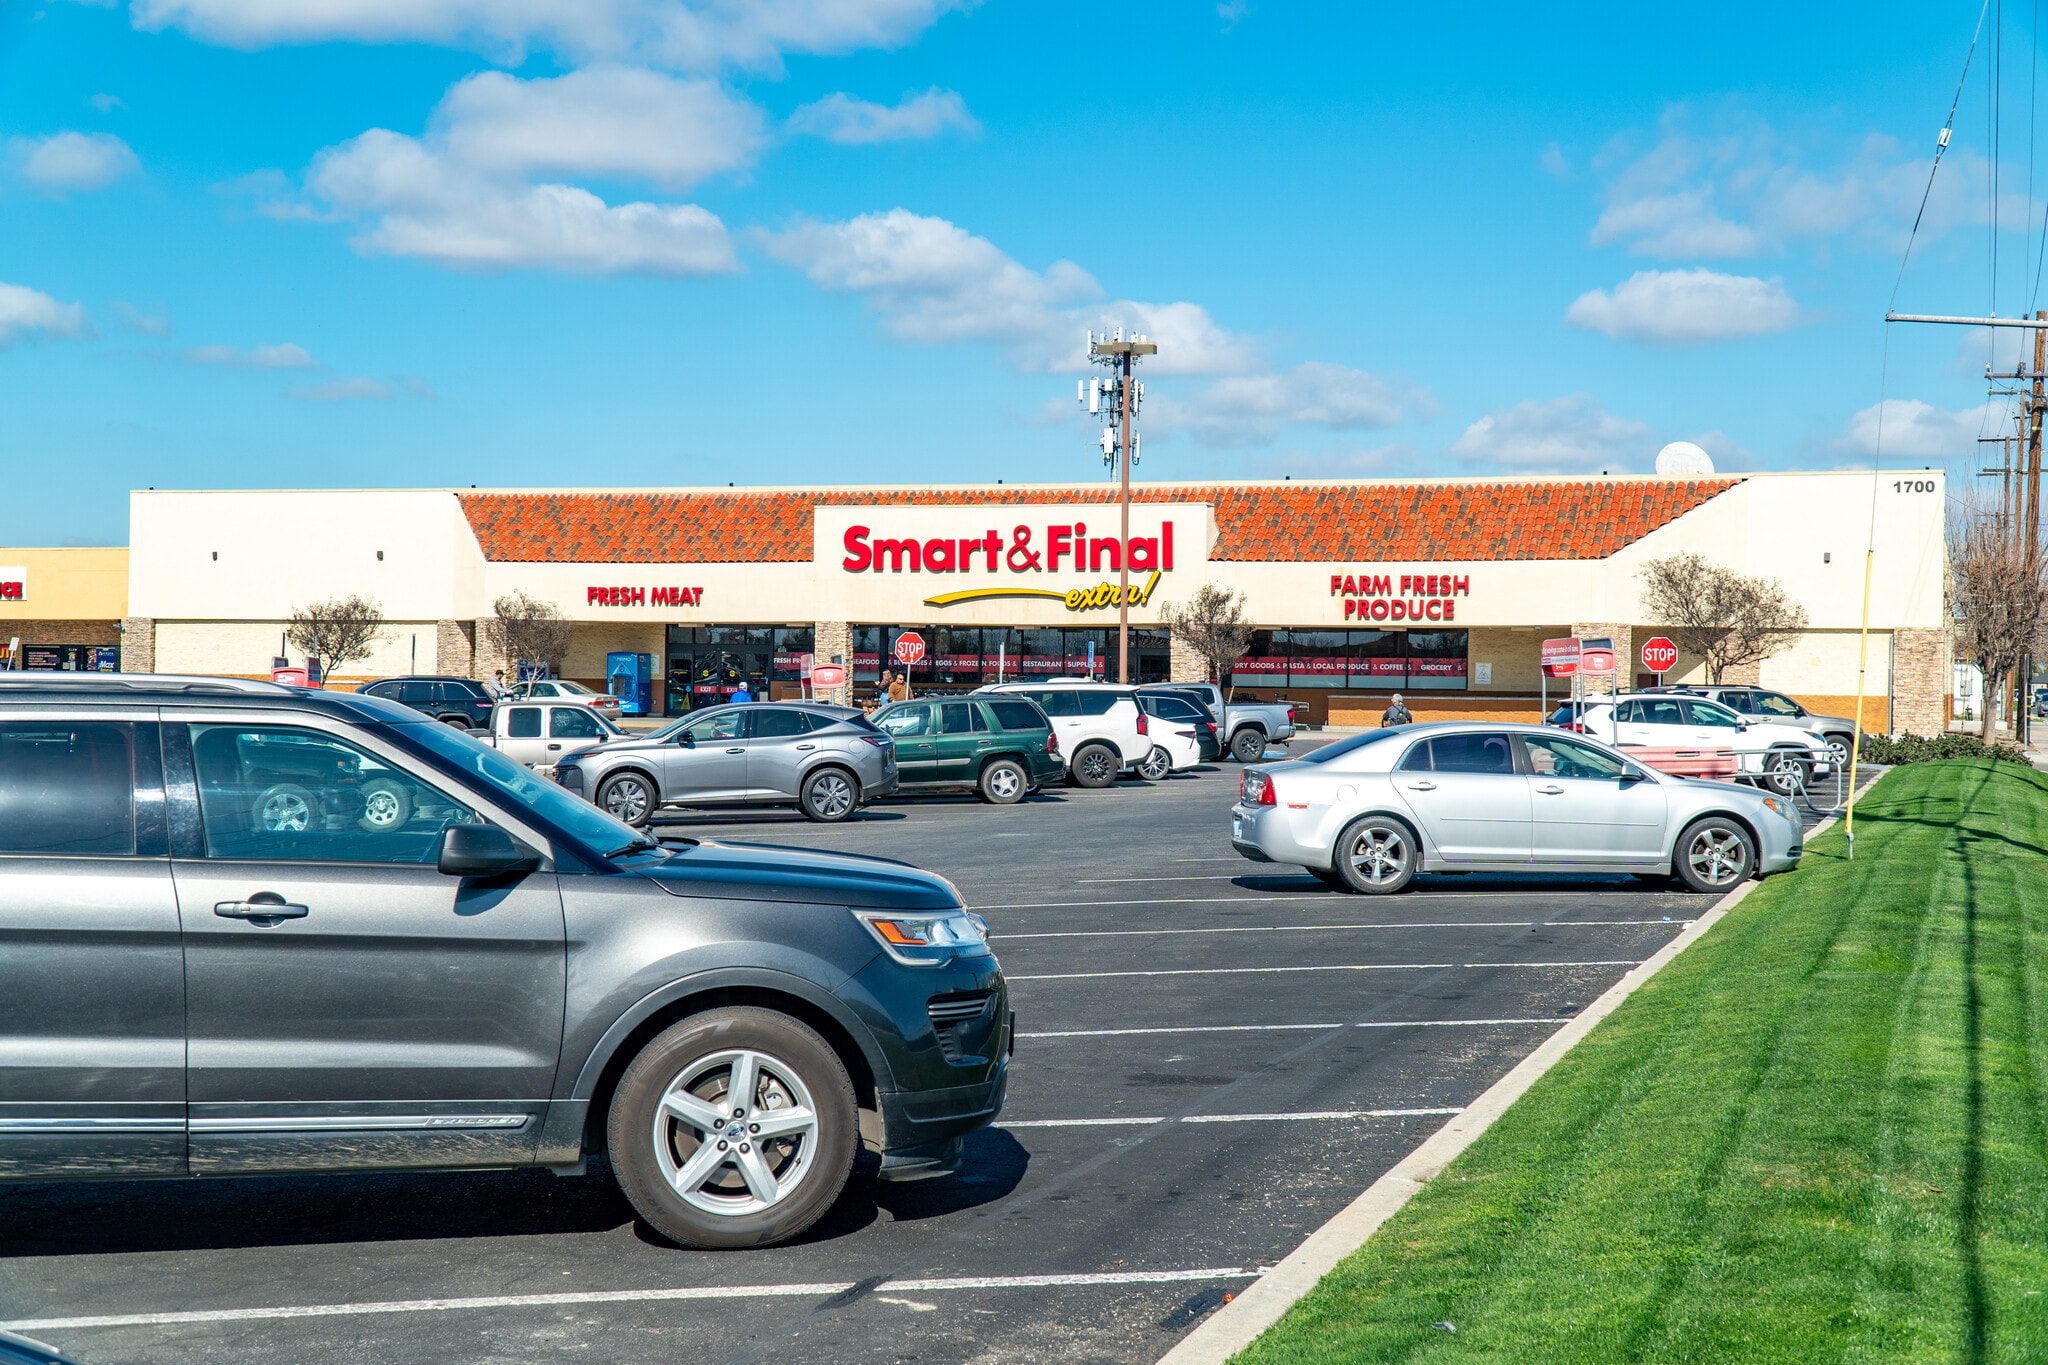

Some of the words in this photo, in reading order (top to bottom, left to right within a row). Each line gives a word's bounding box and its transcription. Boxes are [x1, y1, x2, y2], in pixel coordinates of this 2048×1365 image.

[1893, 480, 1935, 493] 1700
[0, 581, 23, 600] CE
[1065, 570, 1160, 609] extra!
[1330, 575, 1393, 596] FARM
[1400, 575, 1470, 596] FRESH
[587, 587, 646, 606] FRESH
[651, 587, 704, 606] MEAT
[1344, 599, 1455, 620] PRODUCE
[897, 641, 923, 655] STOP
[1644, 648, 1676, 661] STOP
[773, 657, 792, 665] FRESH
